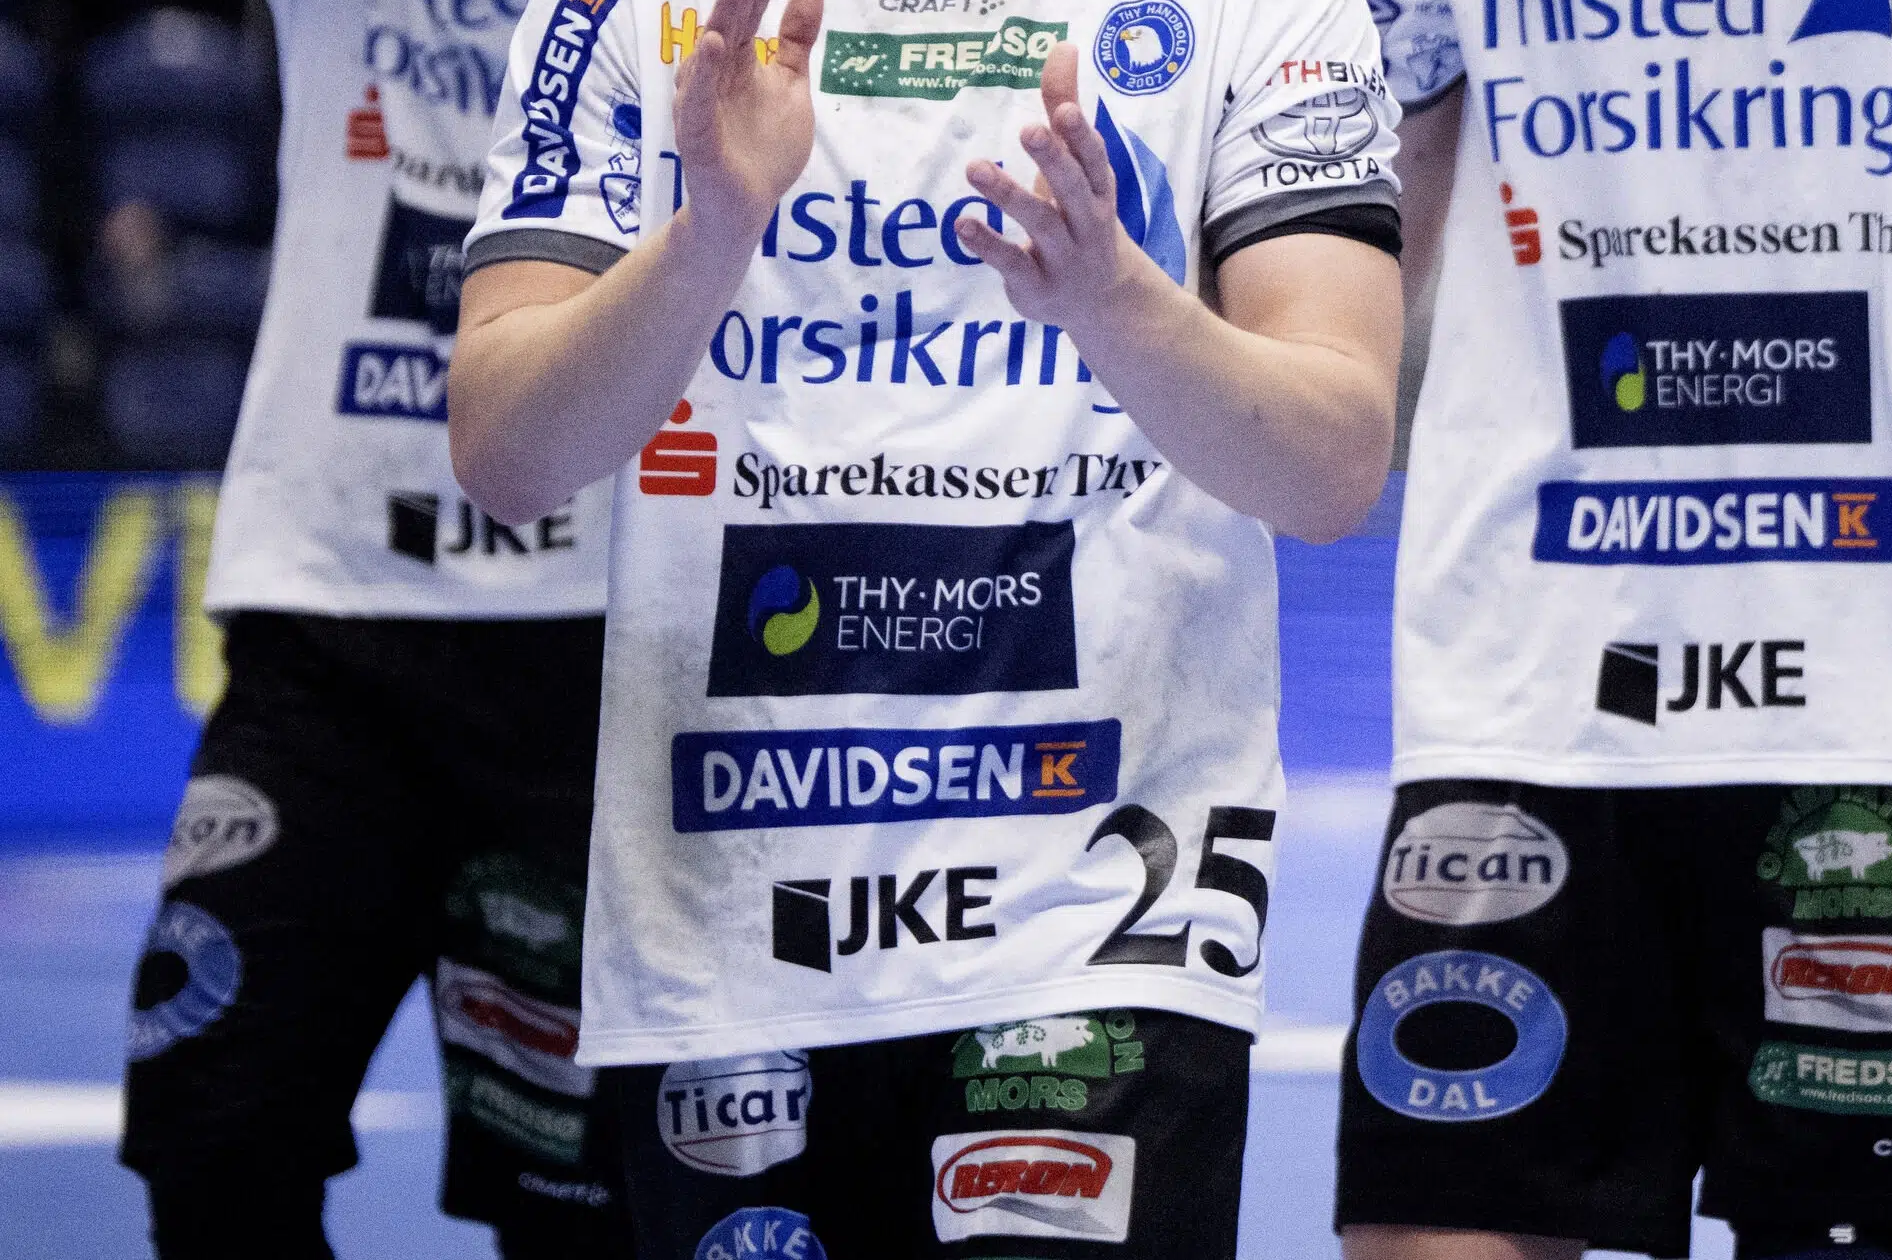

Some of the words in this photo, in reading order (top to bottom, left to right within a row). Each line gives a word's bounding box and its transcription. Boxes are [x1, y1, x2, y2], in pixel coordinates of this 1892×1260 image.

[1101, 24, 1116, 61] MORS
[1118, 7, 1141, 23] THY
[1126, 73, 1163, 88] 2007
[1260, 157, 1379, 187] TOYOTA
[659, 150, 1003, 267] sted
[1558, 213, 1840, 268] Sparekassen
[709, 290, 1125, 414] orsikrin
[1656, 374, 1785, 408] ENERGI
[1567, 491, 1828, 552] DAVIDSEN
[837, 615, 984, 651] ENERGI
[1665, 640, 1807, 713] JKE
[702, 743, 1025, 813] DAVIDSEN
[836, 866, 998, 957] JKE
[1085, 803, 1276, 978] 25
[1383, 960, 1535, 1013] BAKKE
[964, 1078, 1088, 1112] MORS
[1406, 1075, 1498, 1112] DAL
